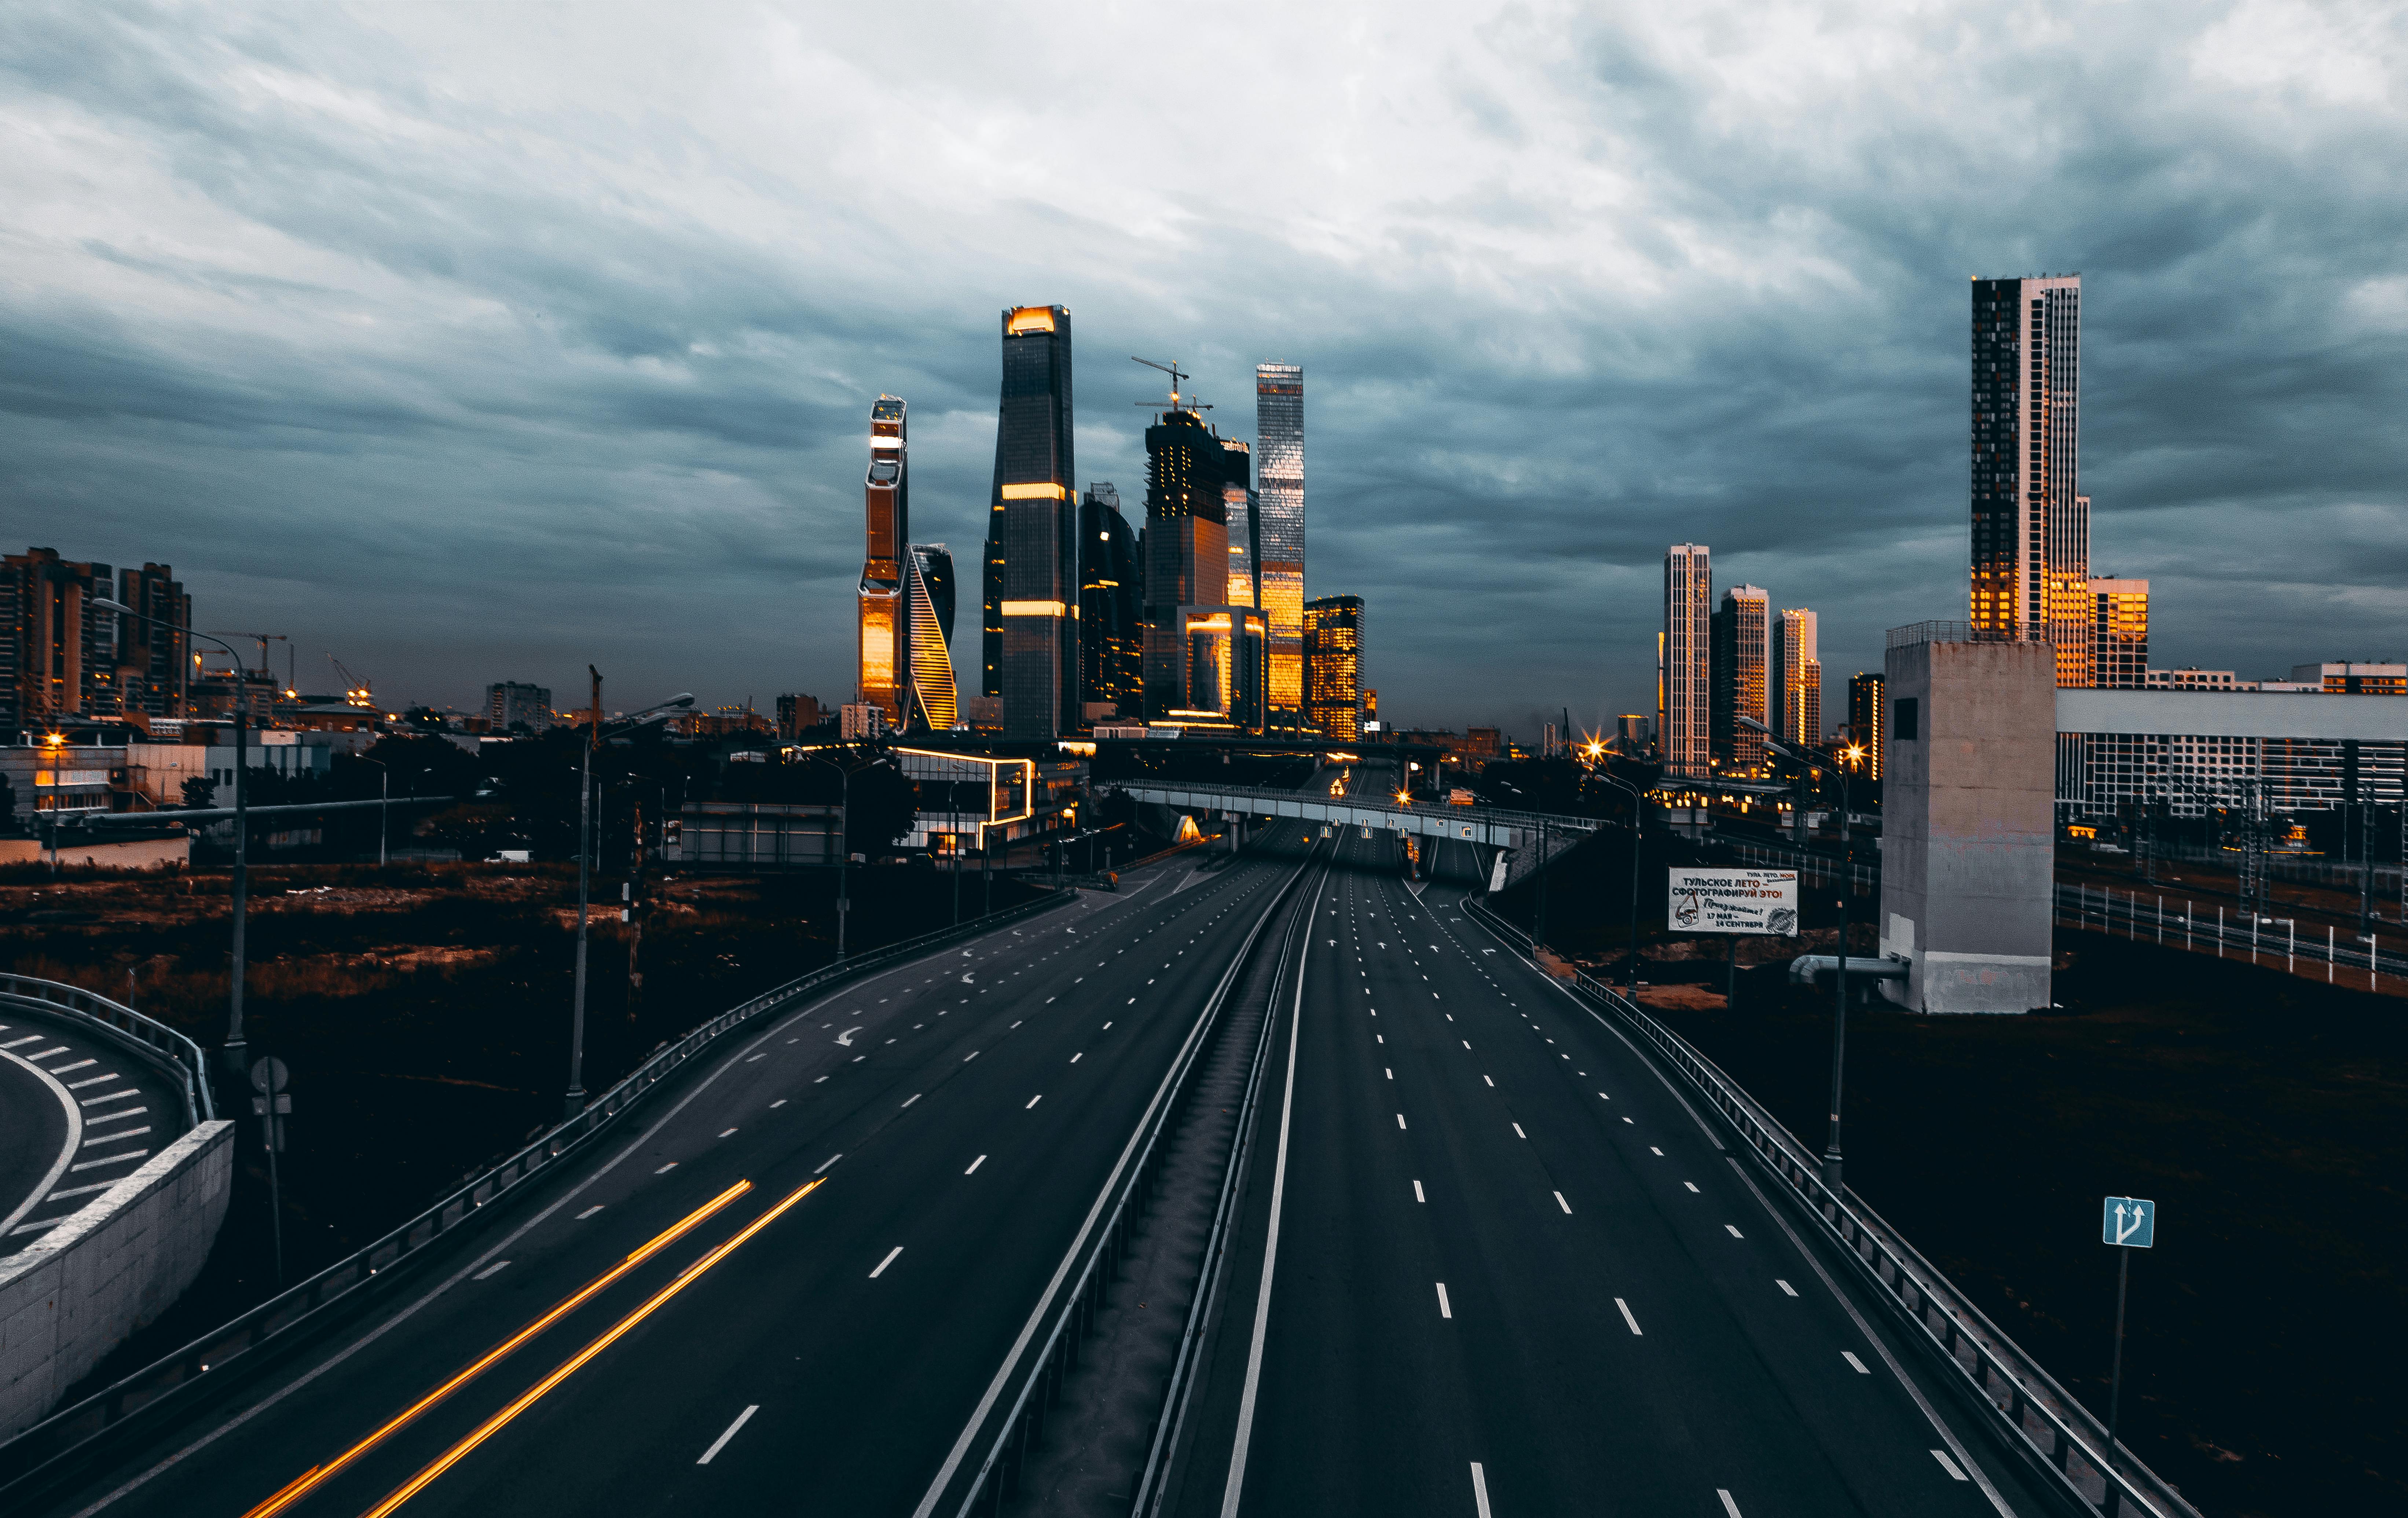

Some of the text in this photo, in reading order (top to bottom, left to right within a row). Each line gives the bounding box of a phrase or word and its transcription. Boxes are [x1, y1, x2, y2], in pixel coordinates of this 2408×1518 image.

[1683, 877, 1732, 887] ТУЛЬСКОЕ
[1735, 879, 1760, 888] ЛЕТО
[1672, 887, 1782, 898] СФОТОГРАФИРУЙ ЭТО!
